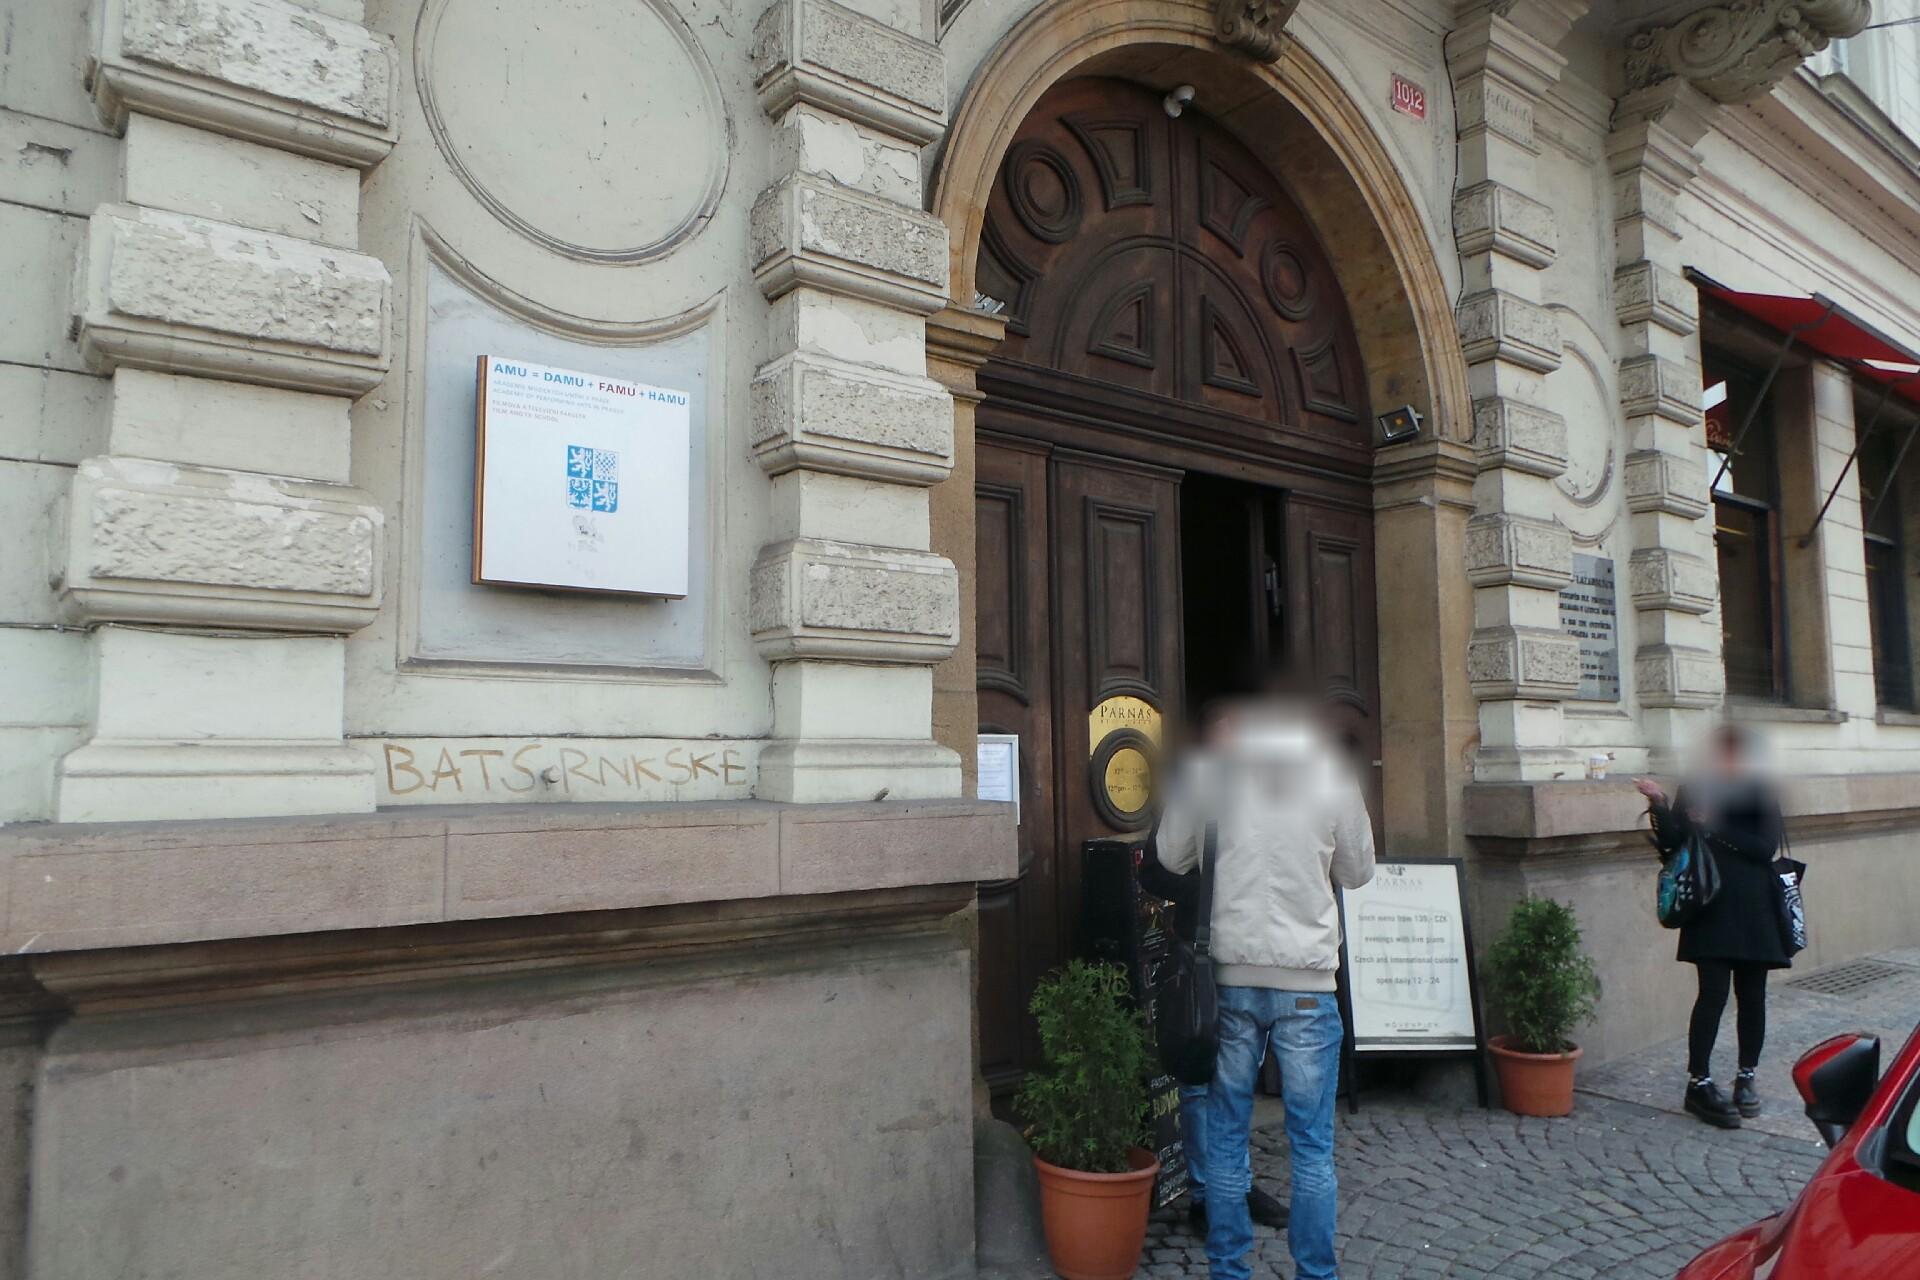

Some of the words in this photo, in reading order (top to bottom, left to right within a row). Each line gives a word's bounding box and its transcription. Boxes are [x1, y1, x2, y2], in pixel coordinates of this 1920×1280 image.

[1396, 80, 1423, 110] 1012
[494, 363, 527, 377] AMU
[544, 372, 584, 388] DAMU
[599, 382, 636, 397] FAMU
[648, 391, 686, 406] HAMU
[1100, 705, 1152, 719] PARNAS
